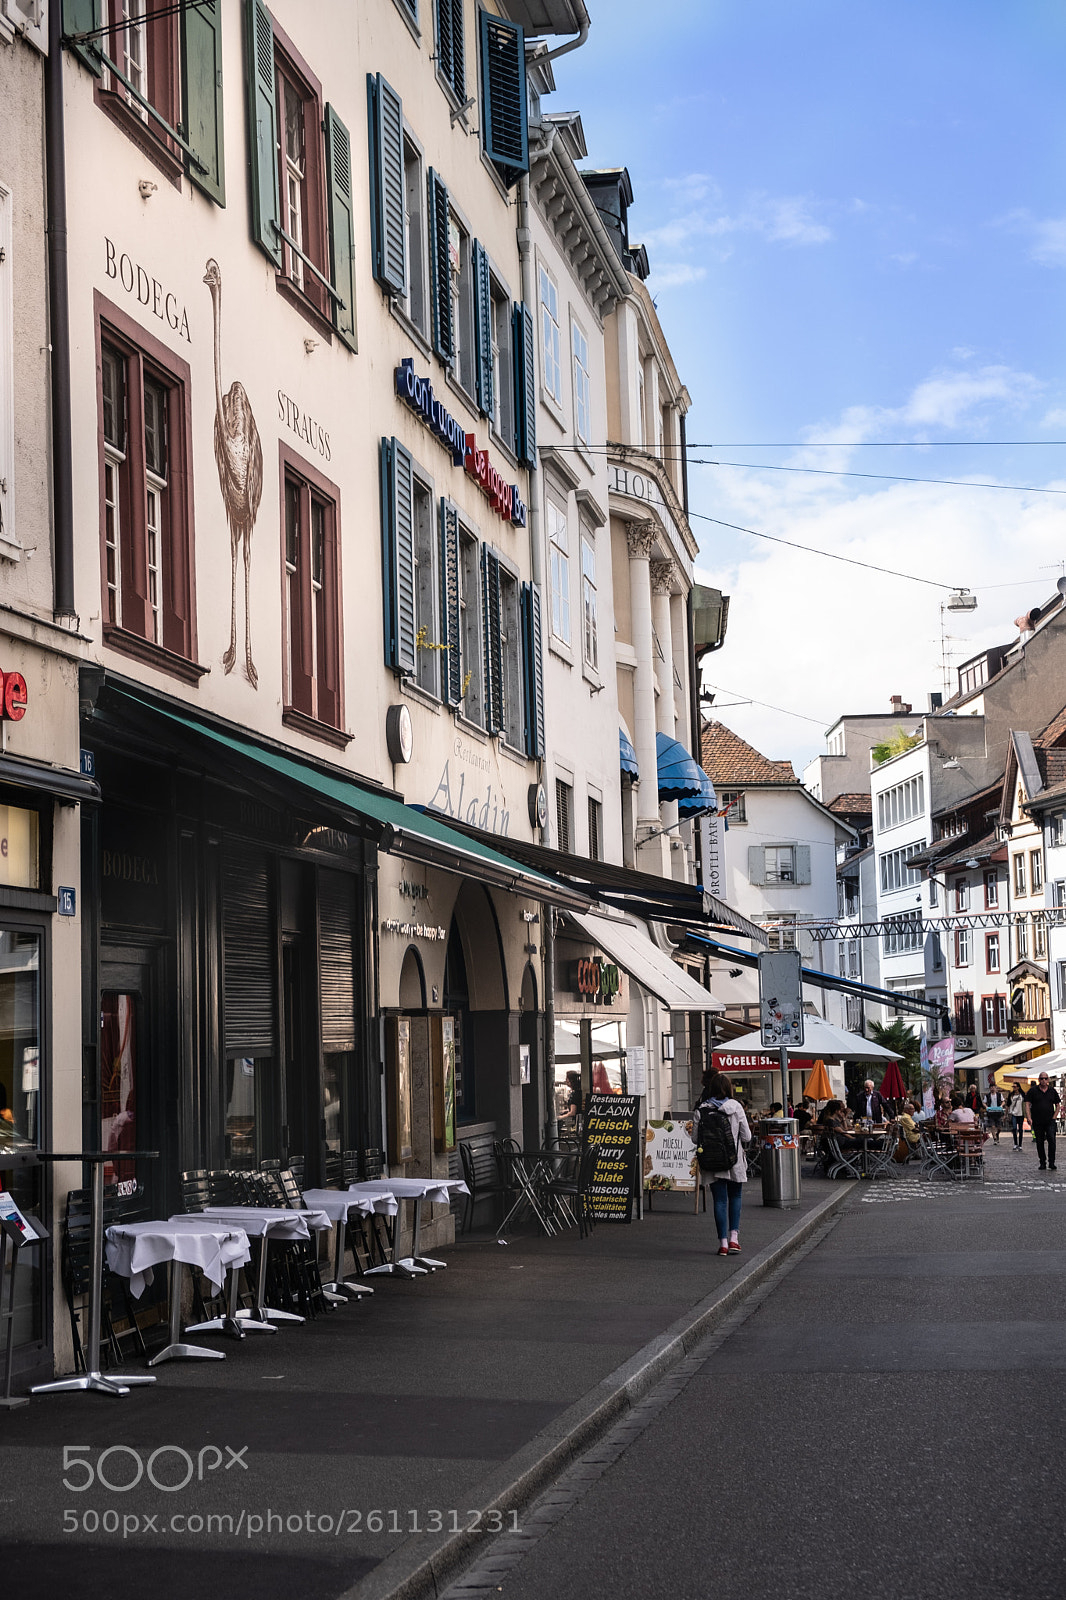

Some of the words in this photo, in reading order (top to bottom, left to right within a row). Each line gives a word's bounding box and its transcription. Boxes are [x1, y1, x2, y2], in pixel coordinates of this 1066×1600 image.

[104, 236, 192, 343] BODEGA
[277, 389, 332, 462] STRAUSS
[607, 465, 652, 503] HOF
[84, 753, 92, 772] 16
[427, 759, 510, 838] Aladin
[708, 820, 718, 845] BAR
[103, 849, 159, 885] BODEGA
[63, 891, 72, 911] 15
[590, 1094, 635, 1104] Restaurant
[588, 1105, 636, 1117] ALADIN
[588, 1118, 633, 1131] Fleisch-
[587, 1133, 632, 1145] spiesse
[608, 1211, 627, 1219] mehr
